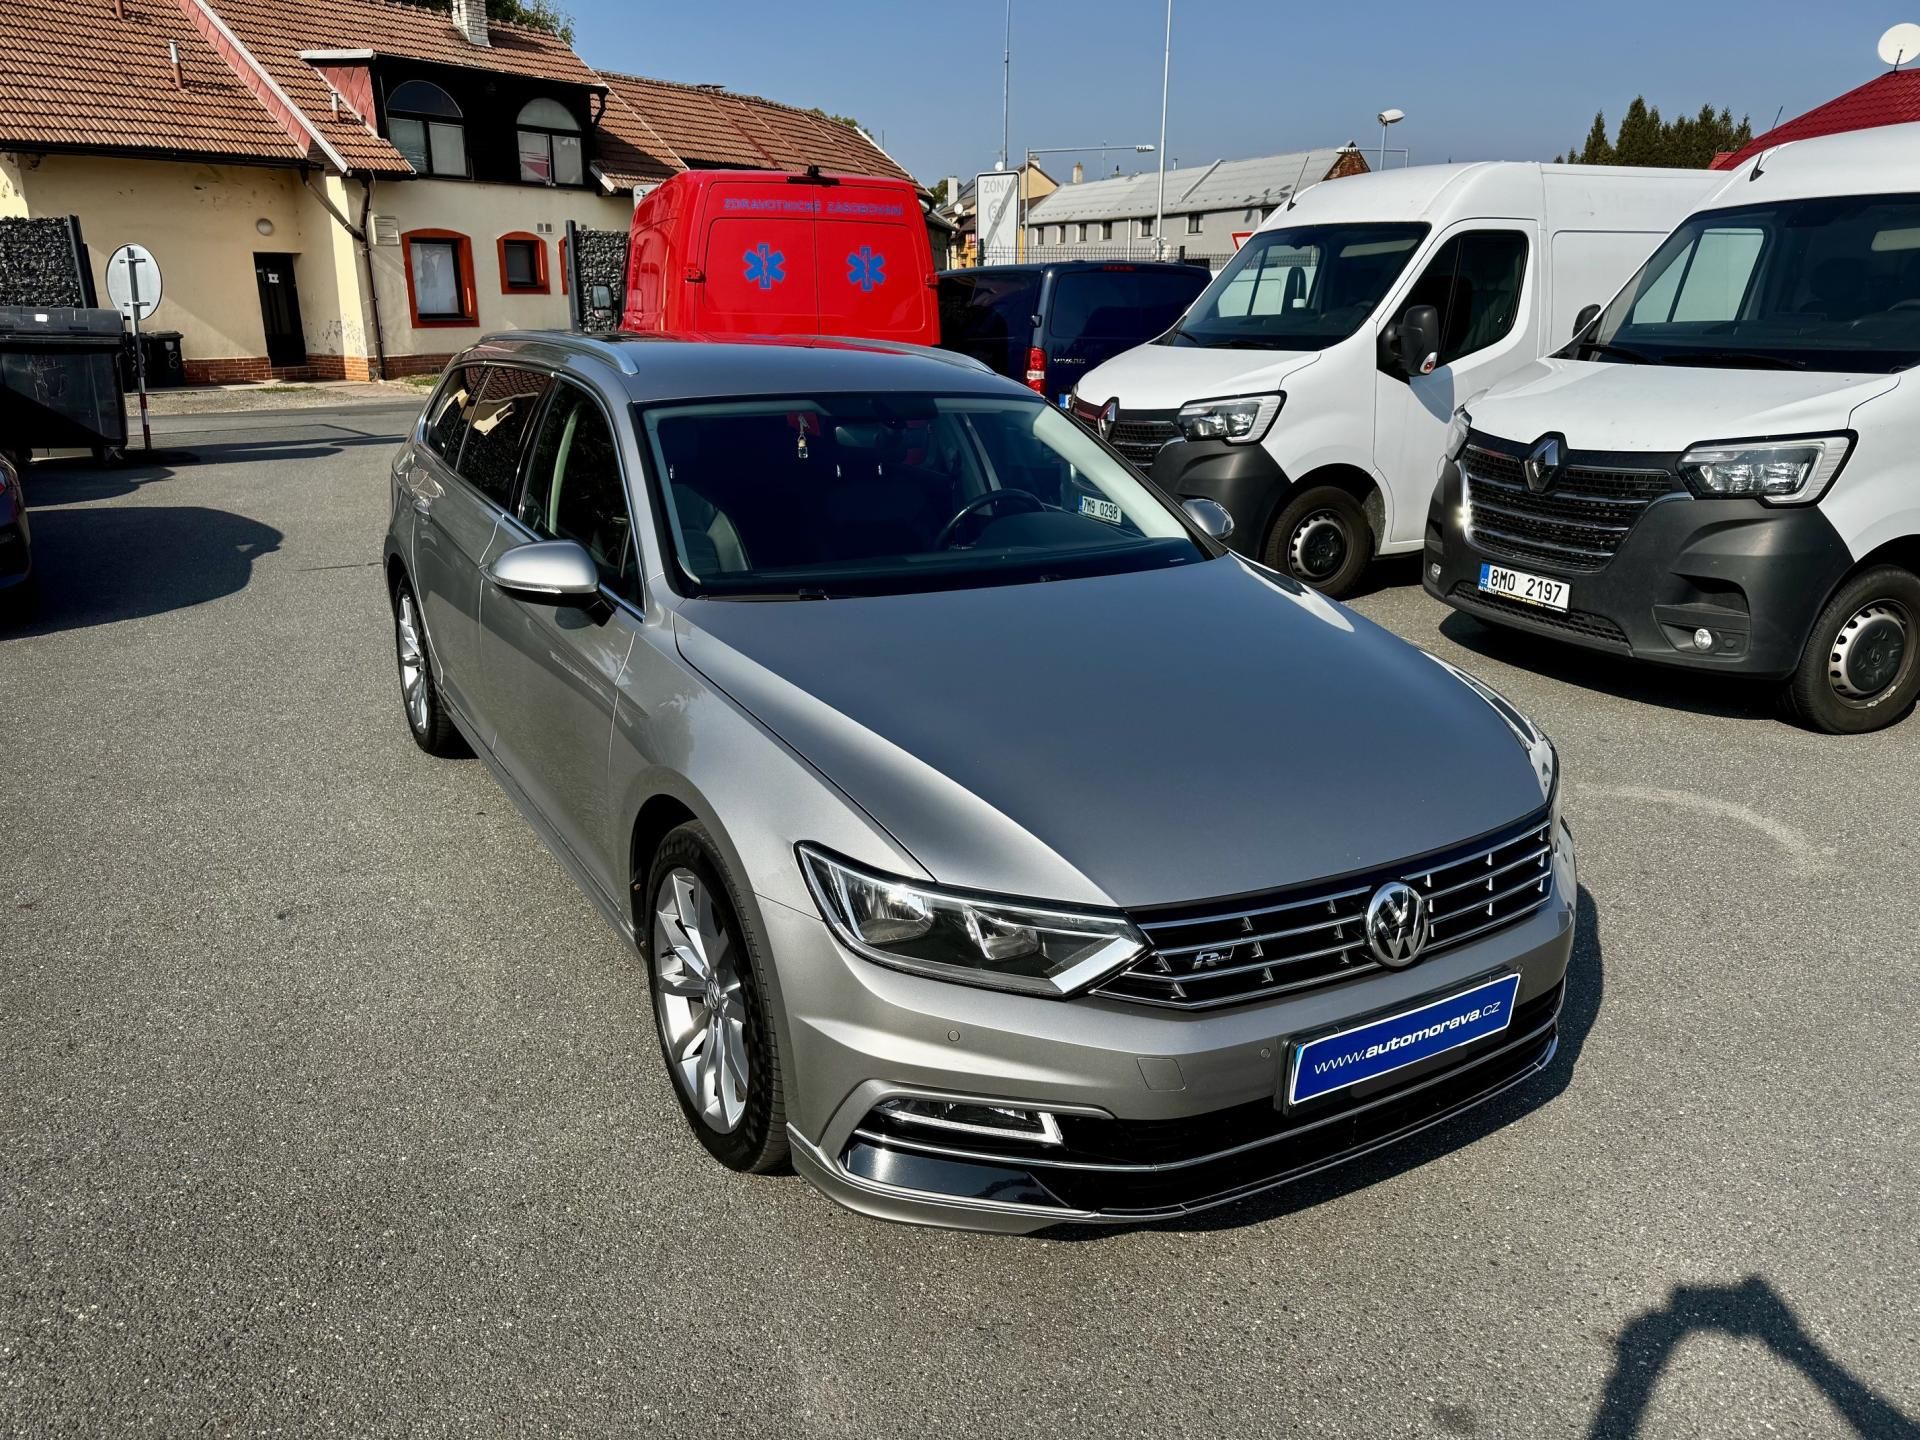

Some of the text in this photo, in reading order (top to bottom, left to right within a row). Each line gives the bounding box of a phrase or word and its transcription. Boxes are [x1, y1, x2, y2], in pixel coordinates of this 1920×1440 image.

[1100, 502, 1118, 520] 0298
[1525, 578, 1562, 603] 2197
[1314, 1001, 1501, 1075] www.automorava.cz
